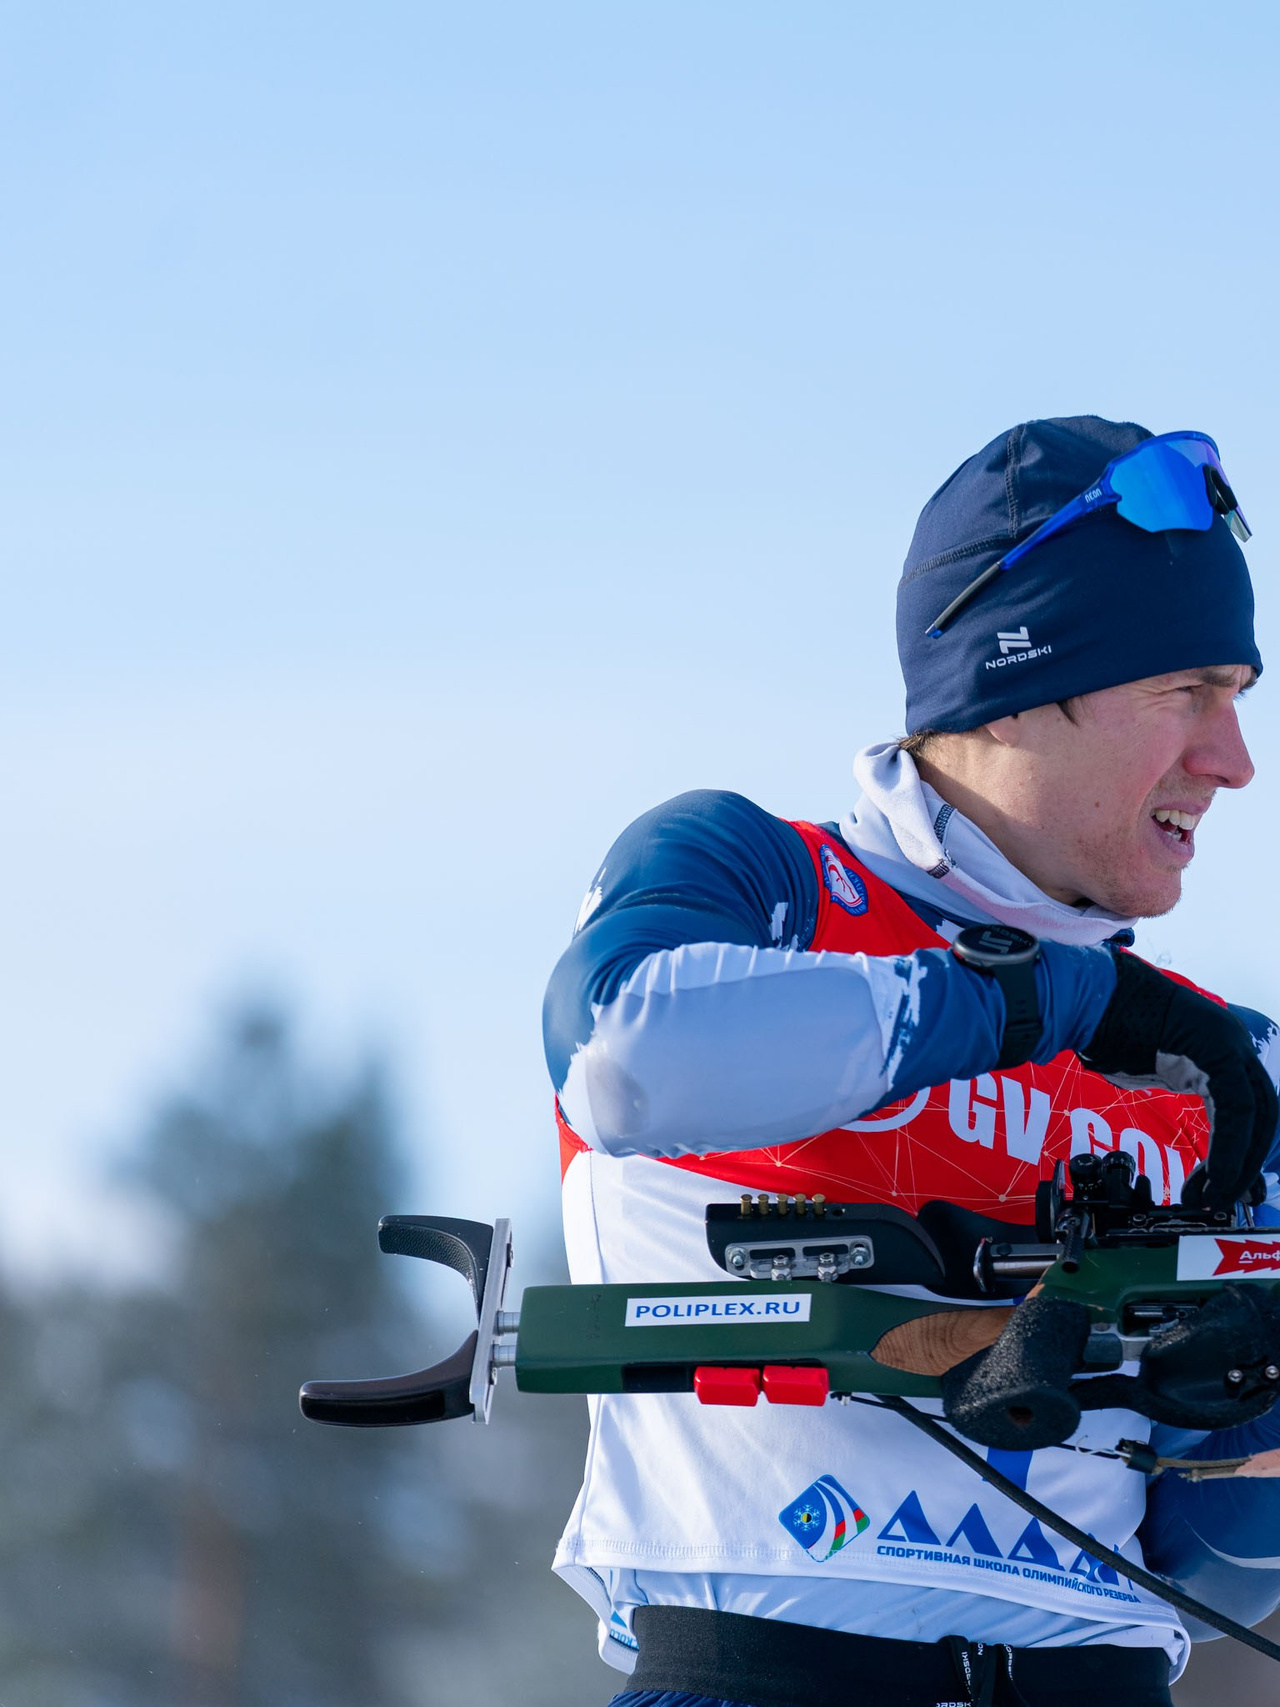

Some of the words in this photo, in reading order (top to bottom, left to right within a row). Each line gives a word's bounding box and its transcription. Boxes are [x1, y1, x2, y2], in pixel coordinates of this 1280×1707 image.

[985, 645, 1052, 670] NORDSKI
[947, 1072, 1050, 1166] GV
[635, 1301, 800, 1318] POLIPLEX.RU
[876, 1546, 970, 1566] СПОРТИВНАЯ
[973, 1558, 1020, 1576] ШКОЛА
[1022, 1567, 1102, 1597] ОЛИМПИЙСКОГО
[1103, 1588, 1141, 1603] РЕЗЕРВА
